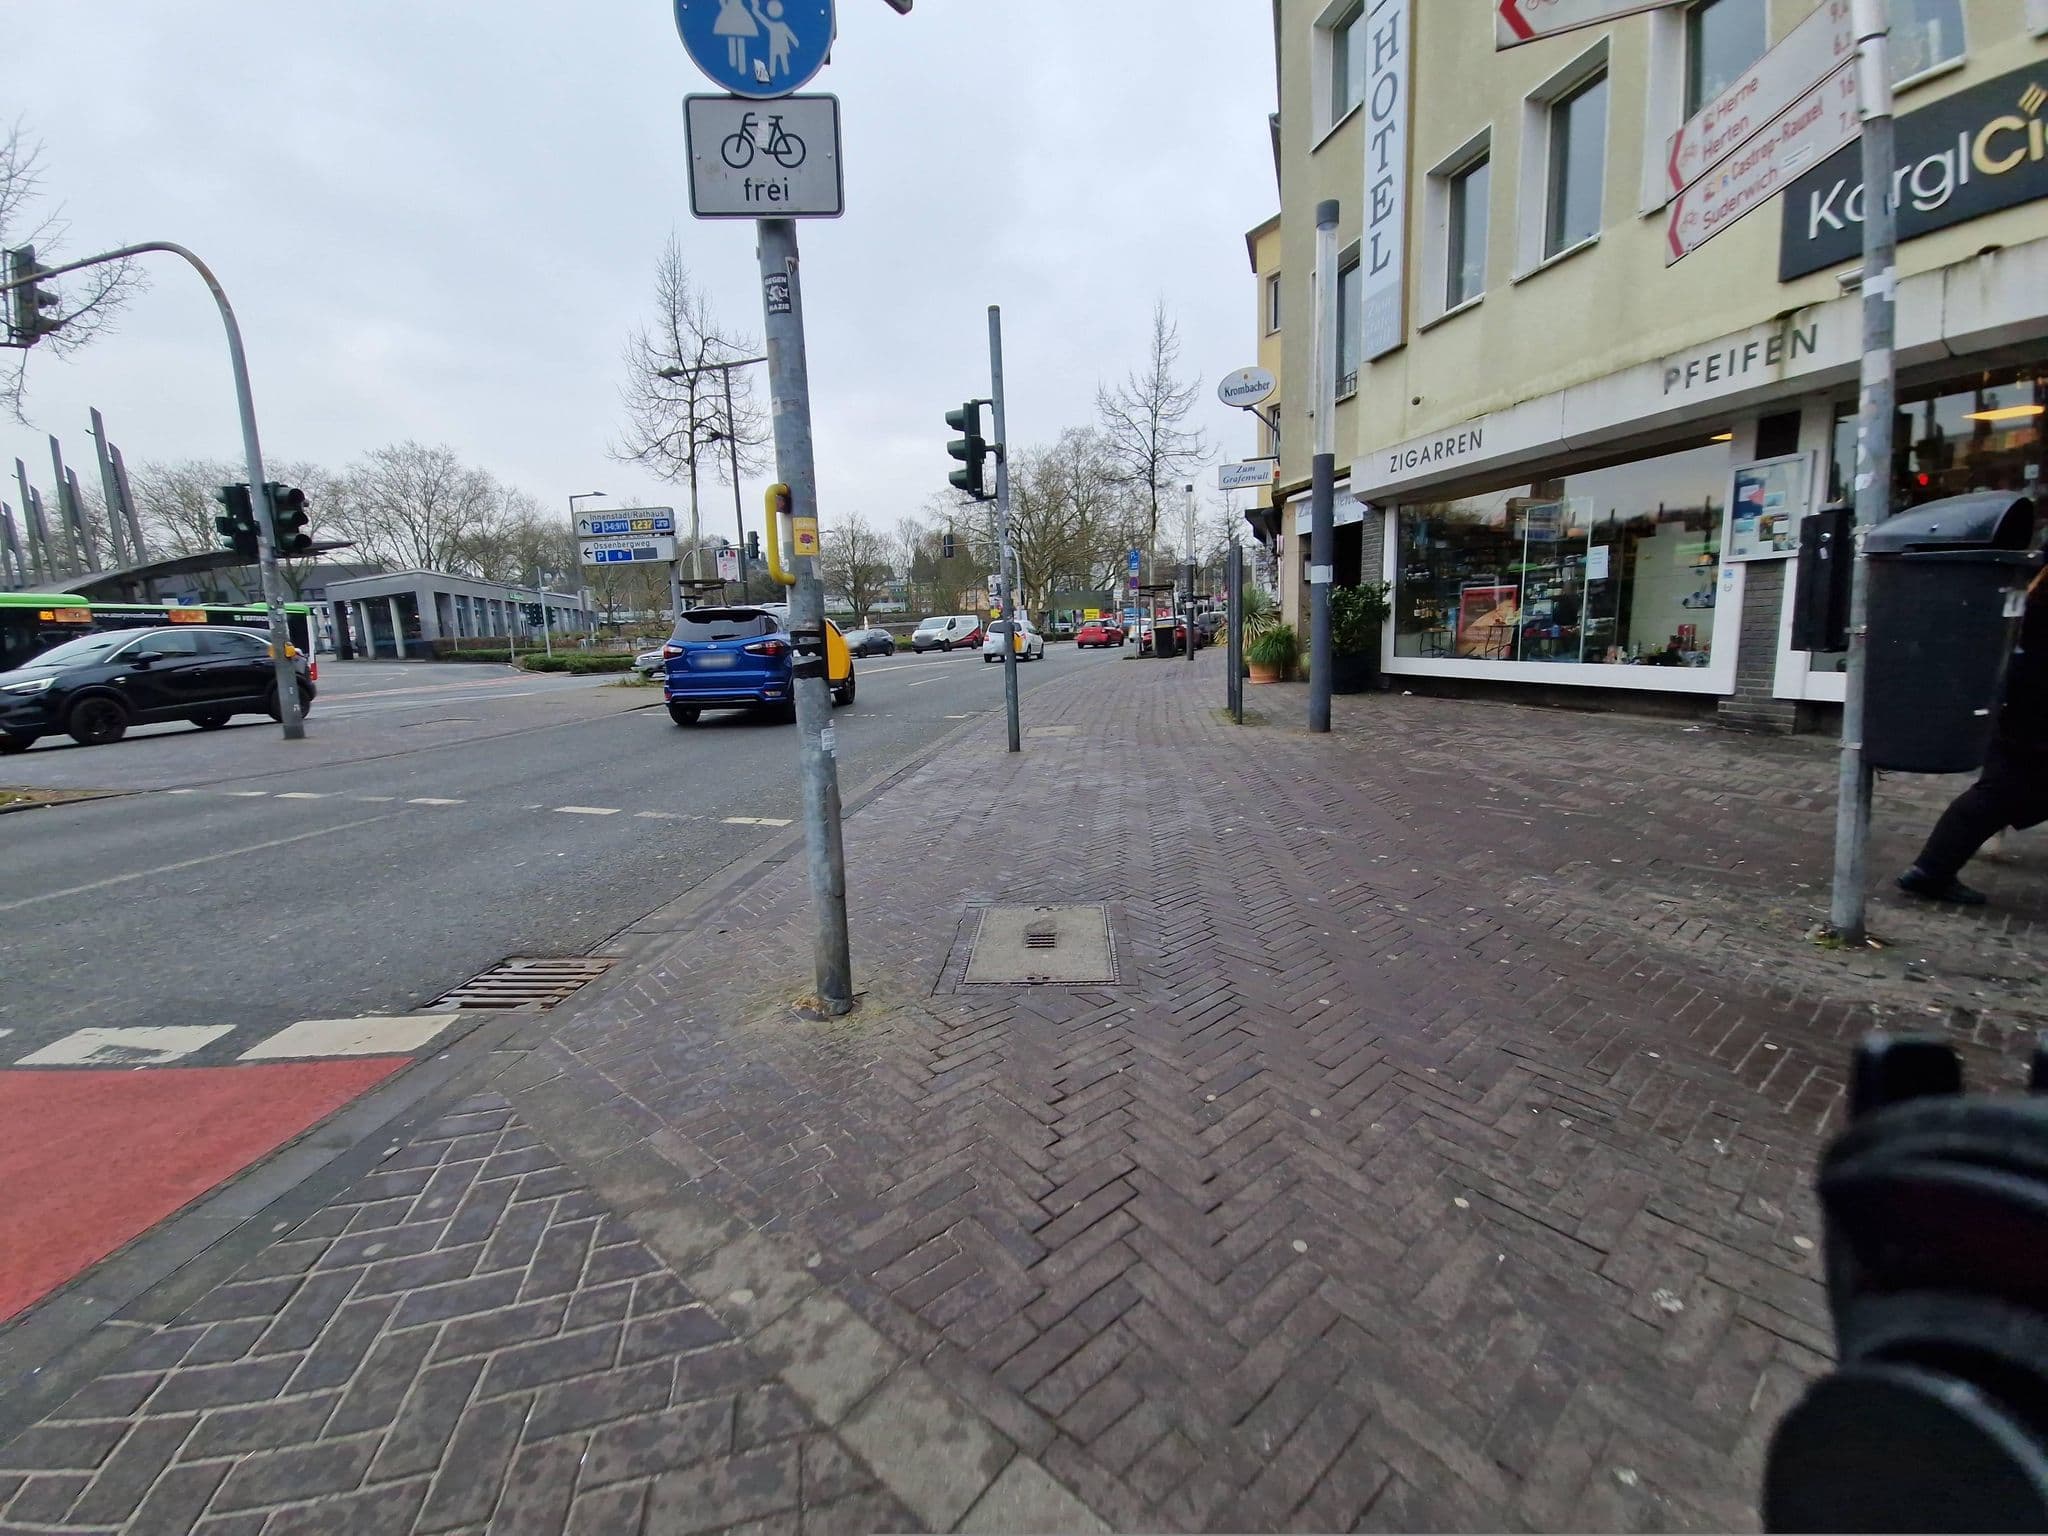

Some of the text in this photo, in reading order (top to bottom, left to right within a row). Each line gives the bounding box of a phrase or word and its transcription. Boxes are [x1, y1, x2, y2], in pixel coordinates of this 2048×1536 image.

[1717, 78, 1758, 119] Herne
[1370, 8, 1400, 276] HOTEL
[1703, 115, 1749, 161] Herten
[1732, 95, 1824, 179] Castrop-Rauxel
[744, 176, 789, 202] frei
[1703, 168, 1777, 230] Suderwich
[1664, 324, 1817, 395] PFEIFEN
[1224, 381, 1270, 398] Krombacher
[1236, 465, 1255, 473] Zum
[1390, 428, 1482, 474] ZIGARREN
[594, 523, 600, 532] P
[594, 541, 650, 549] Ossenbergweg
[597, 553, 603, 561] P
